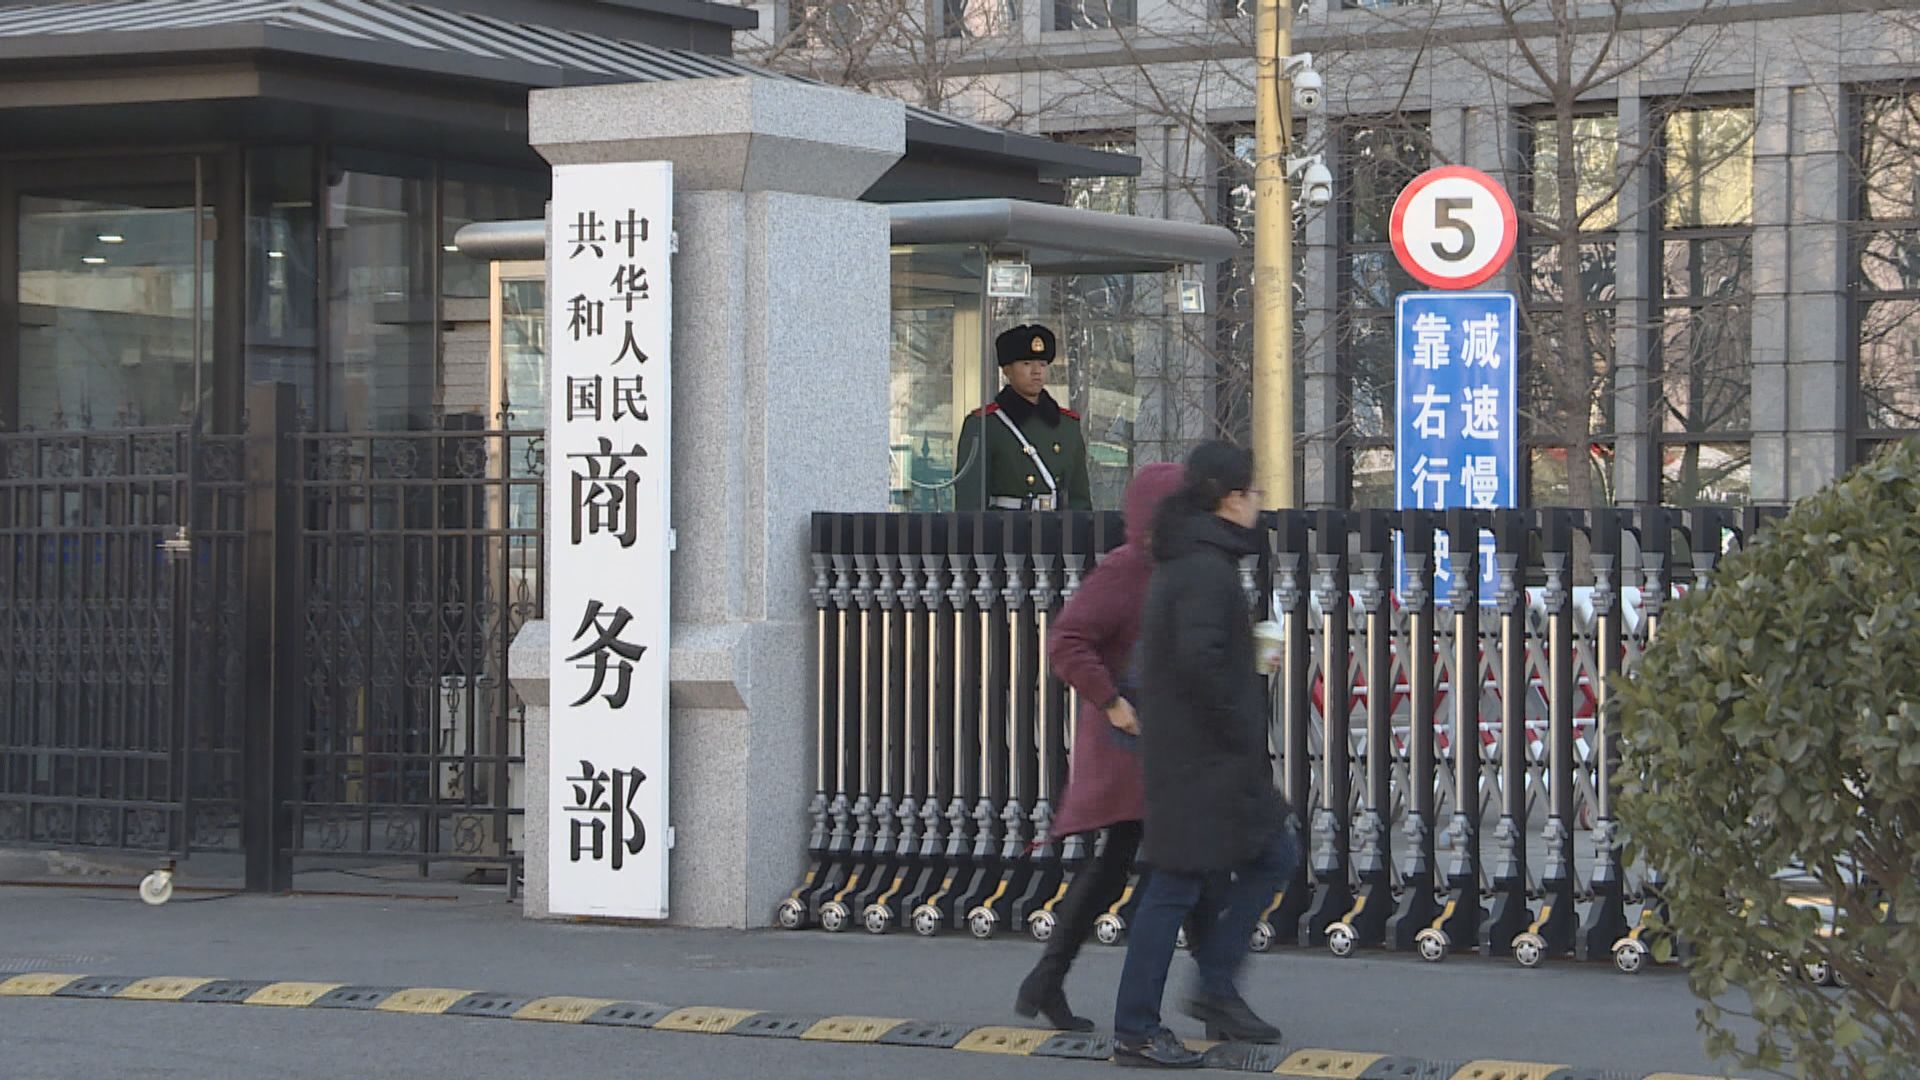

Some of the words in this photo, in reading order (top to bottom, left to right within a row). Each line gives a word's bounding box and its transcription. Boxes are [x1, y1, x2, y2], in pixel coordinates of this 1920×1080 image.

[567, 210, 606, 422] 共和国
[610, 208, 649, 422] 中华人民
[1430, 198, 1476, 262] 5
[563, 436, 648, 871] 商务部
